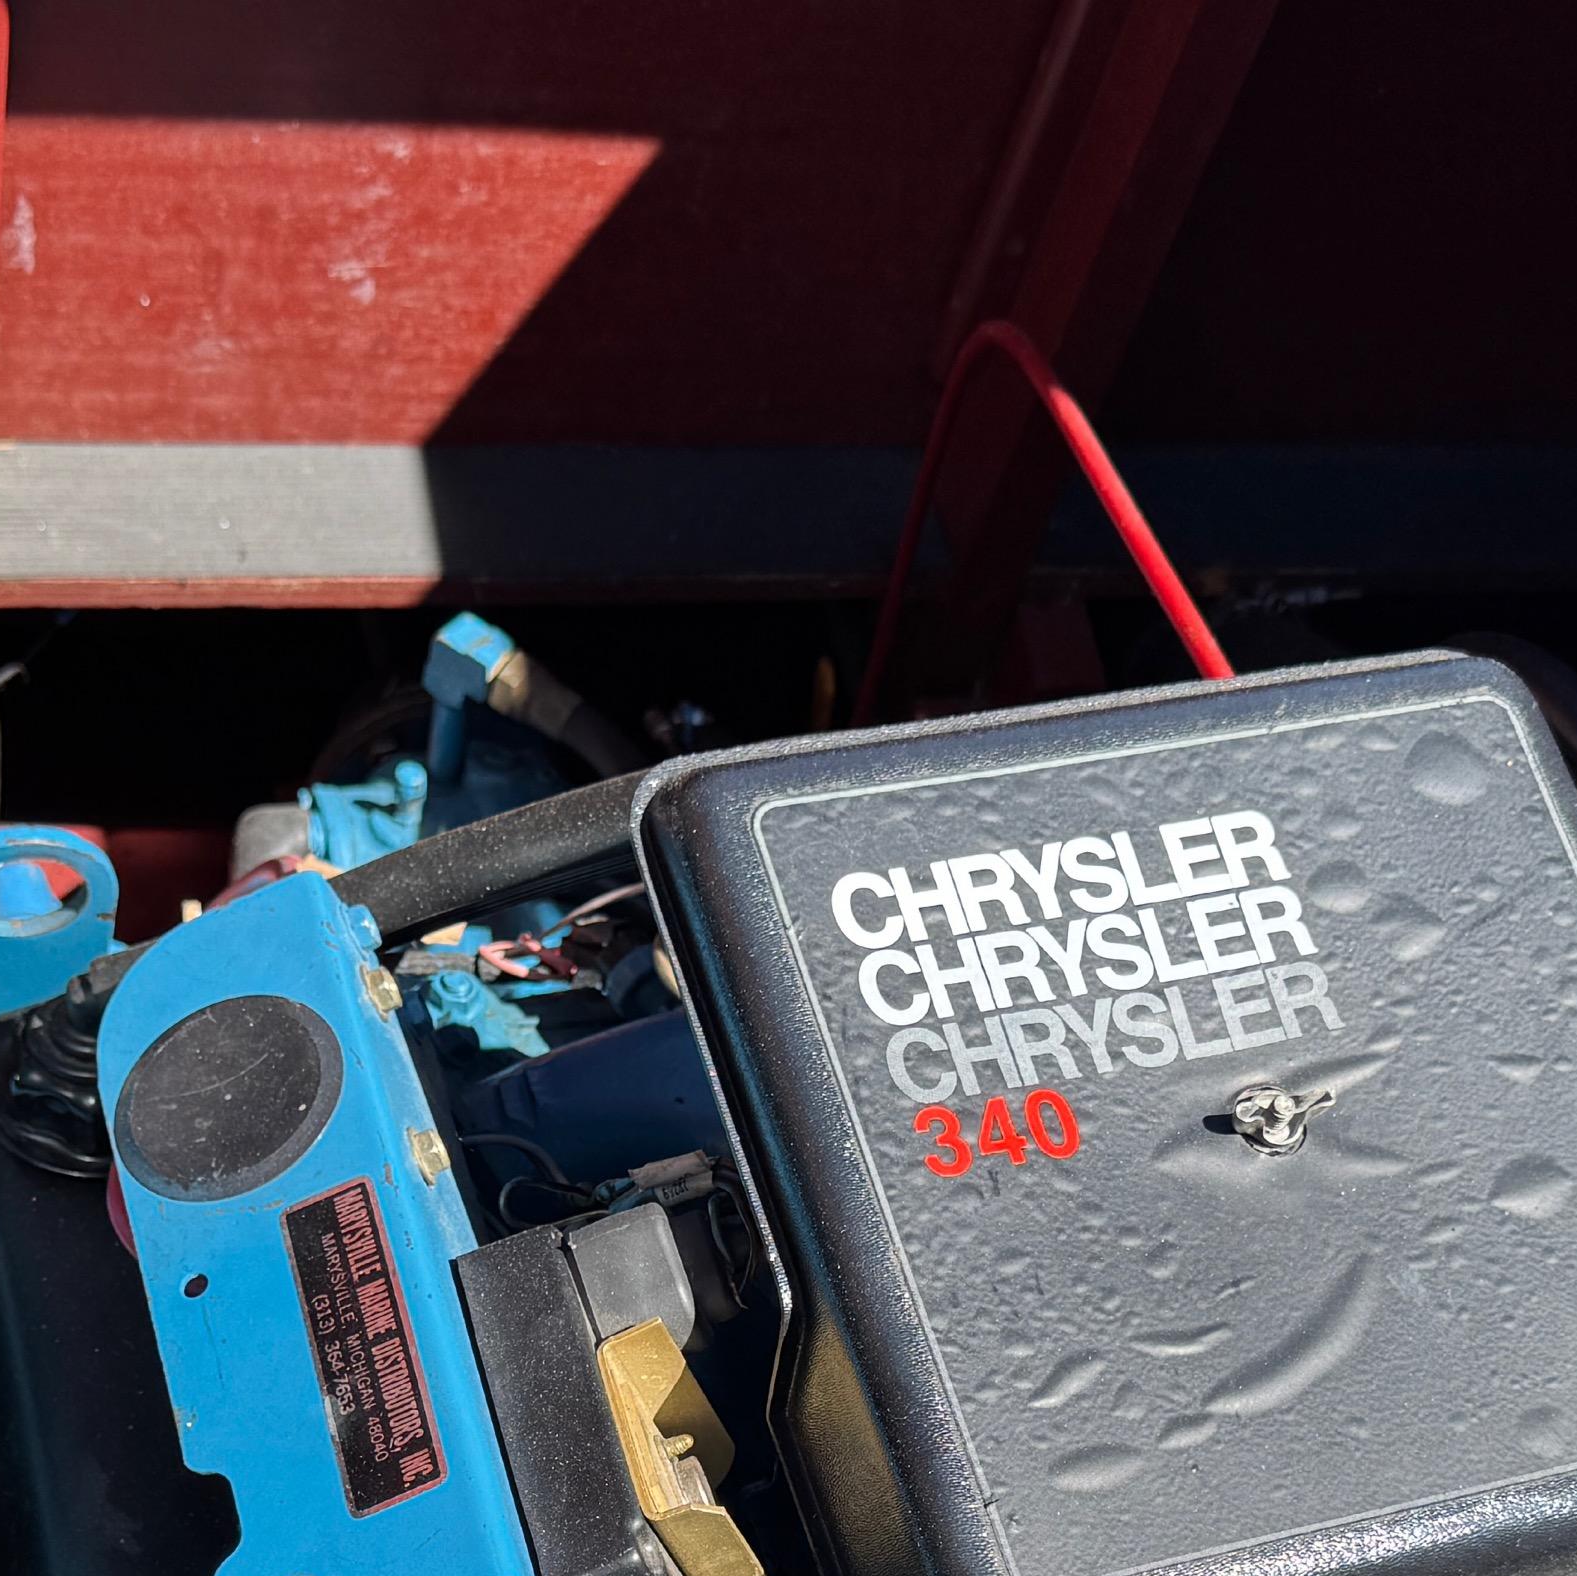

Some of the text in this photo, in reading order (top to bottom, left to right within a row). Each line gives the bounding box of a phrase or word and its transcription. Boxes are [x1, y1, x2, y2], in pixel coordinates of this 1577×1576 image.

[830, 810, 1293, 951] CHRYSLER
[858, 886, 1319, 1026] CHRYSLER
[885, 961, 1346, 1104] CHRYSLER
[912, 1087, 1080, 1178] 340
[311, 1294, 356, 1416] (313) 364-7653
[334, 1187, 434, 1489] MARYSVILLE MARINE DISTRIBUTORS, INC.
[345, 1333, 376, 1411] MICHIGAN
[366, 1416, 390, 1463] 48040
